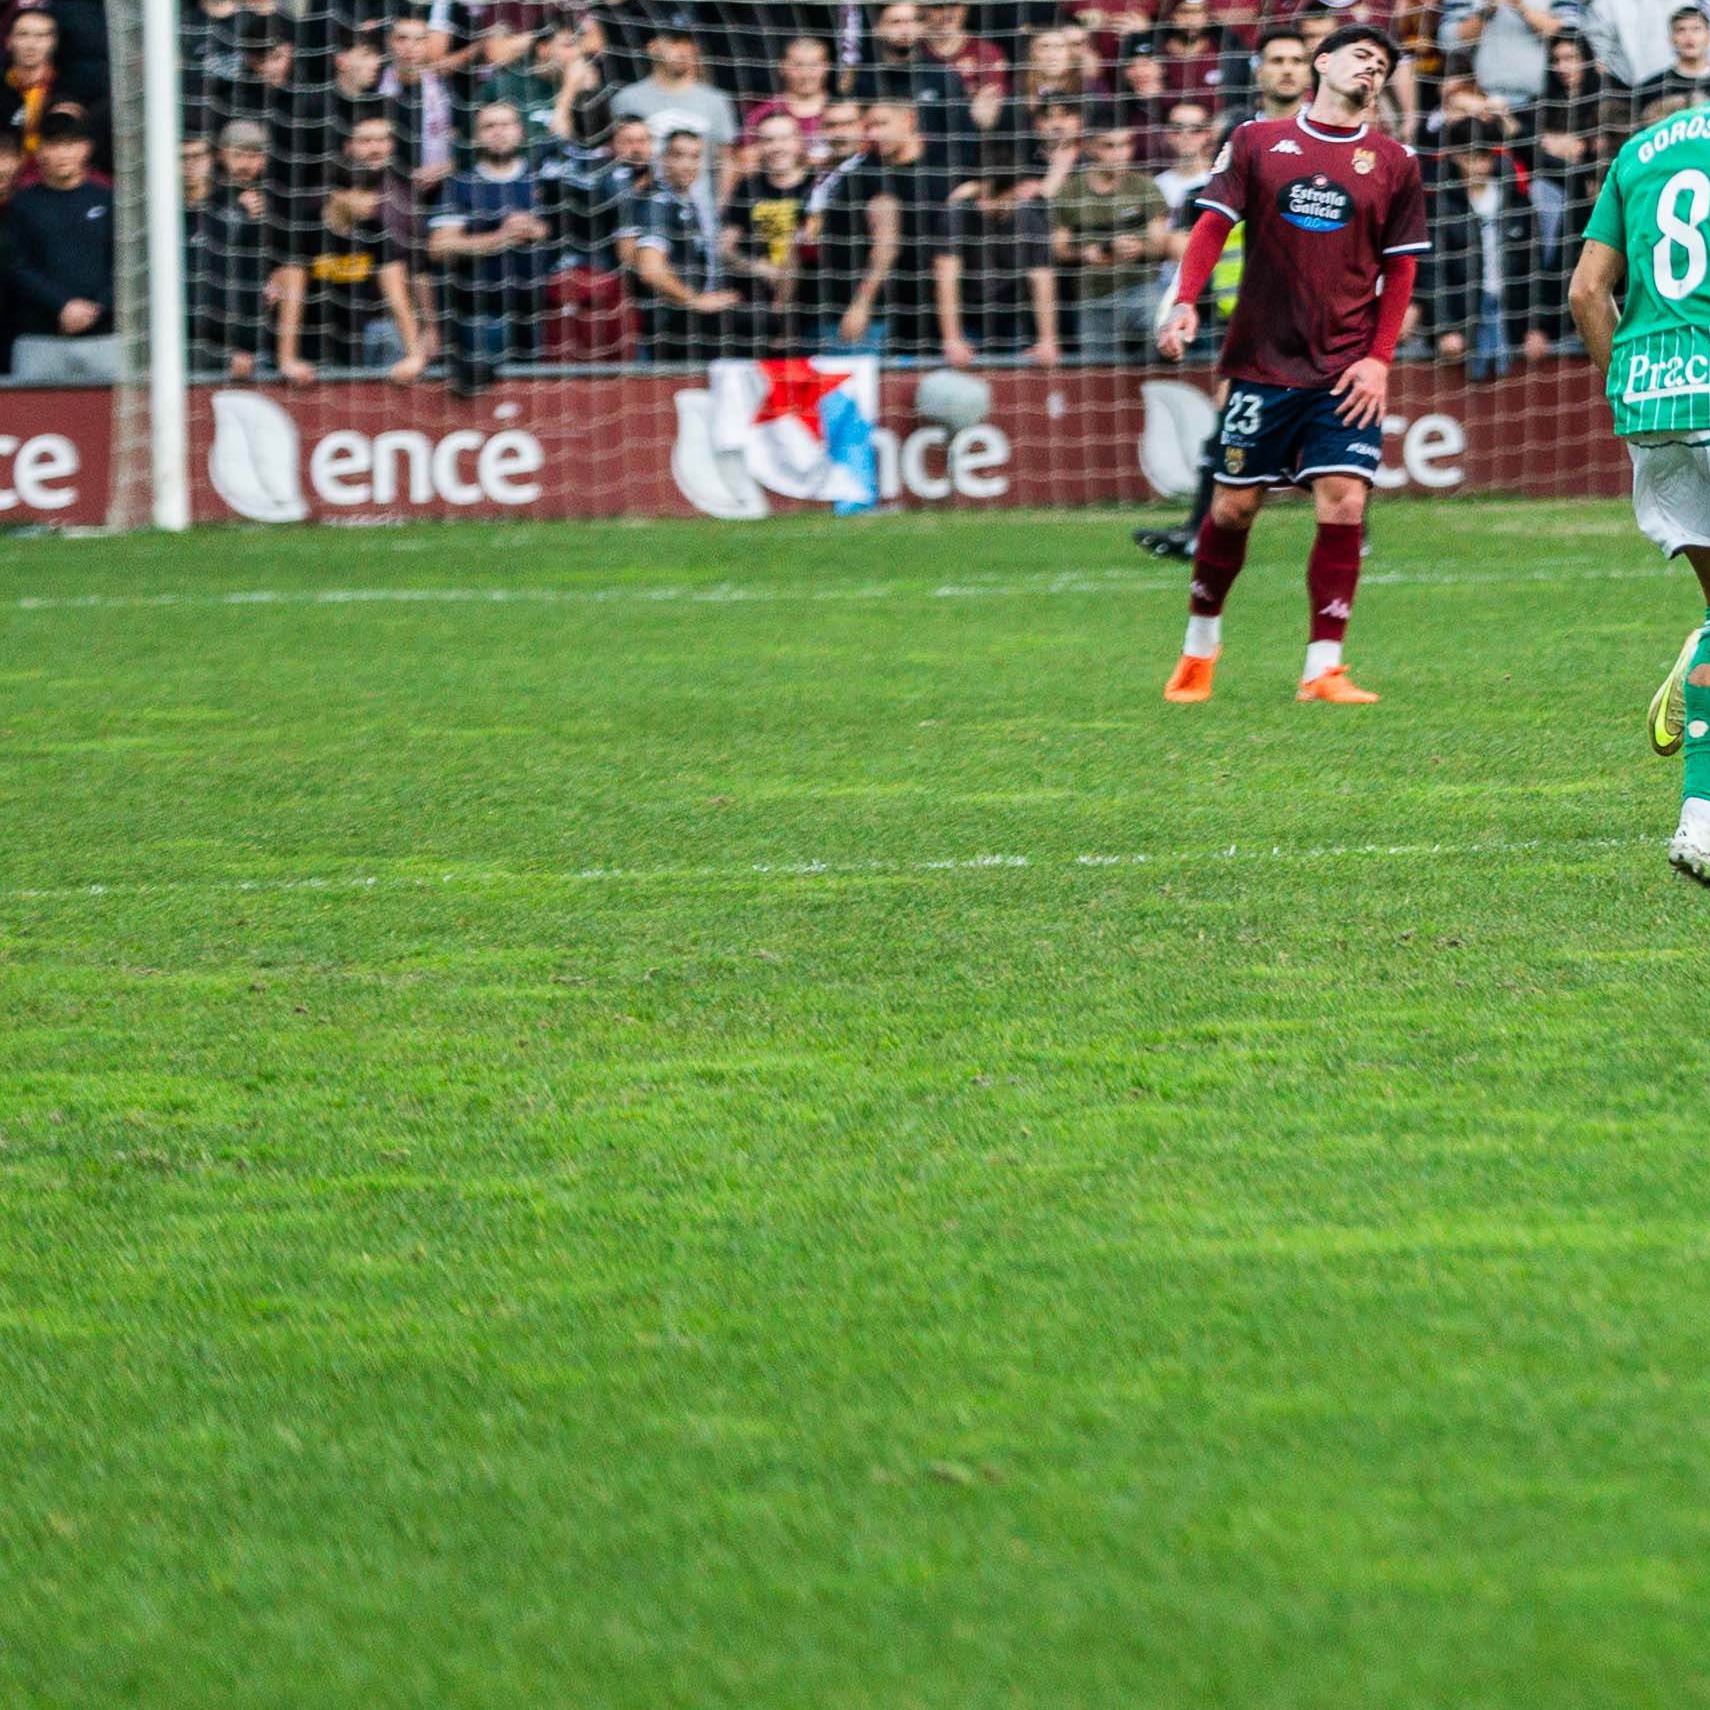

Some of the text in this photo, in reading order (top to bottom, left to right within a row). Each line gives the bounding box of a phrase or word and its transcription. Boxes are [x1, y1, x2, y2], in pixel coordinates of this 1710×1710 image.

[1288, 183, 1348, 207] Estrella
[1289, 198, 1342, 220] Galicia
[1224, 391, 1265, 436] 23
